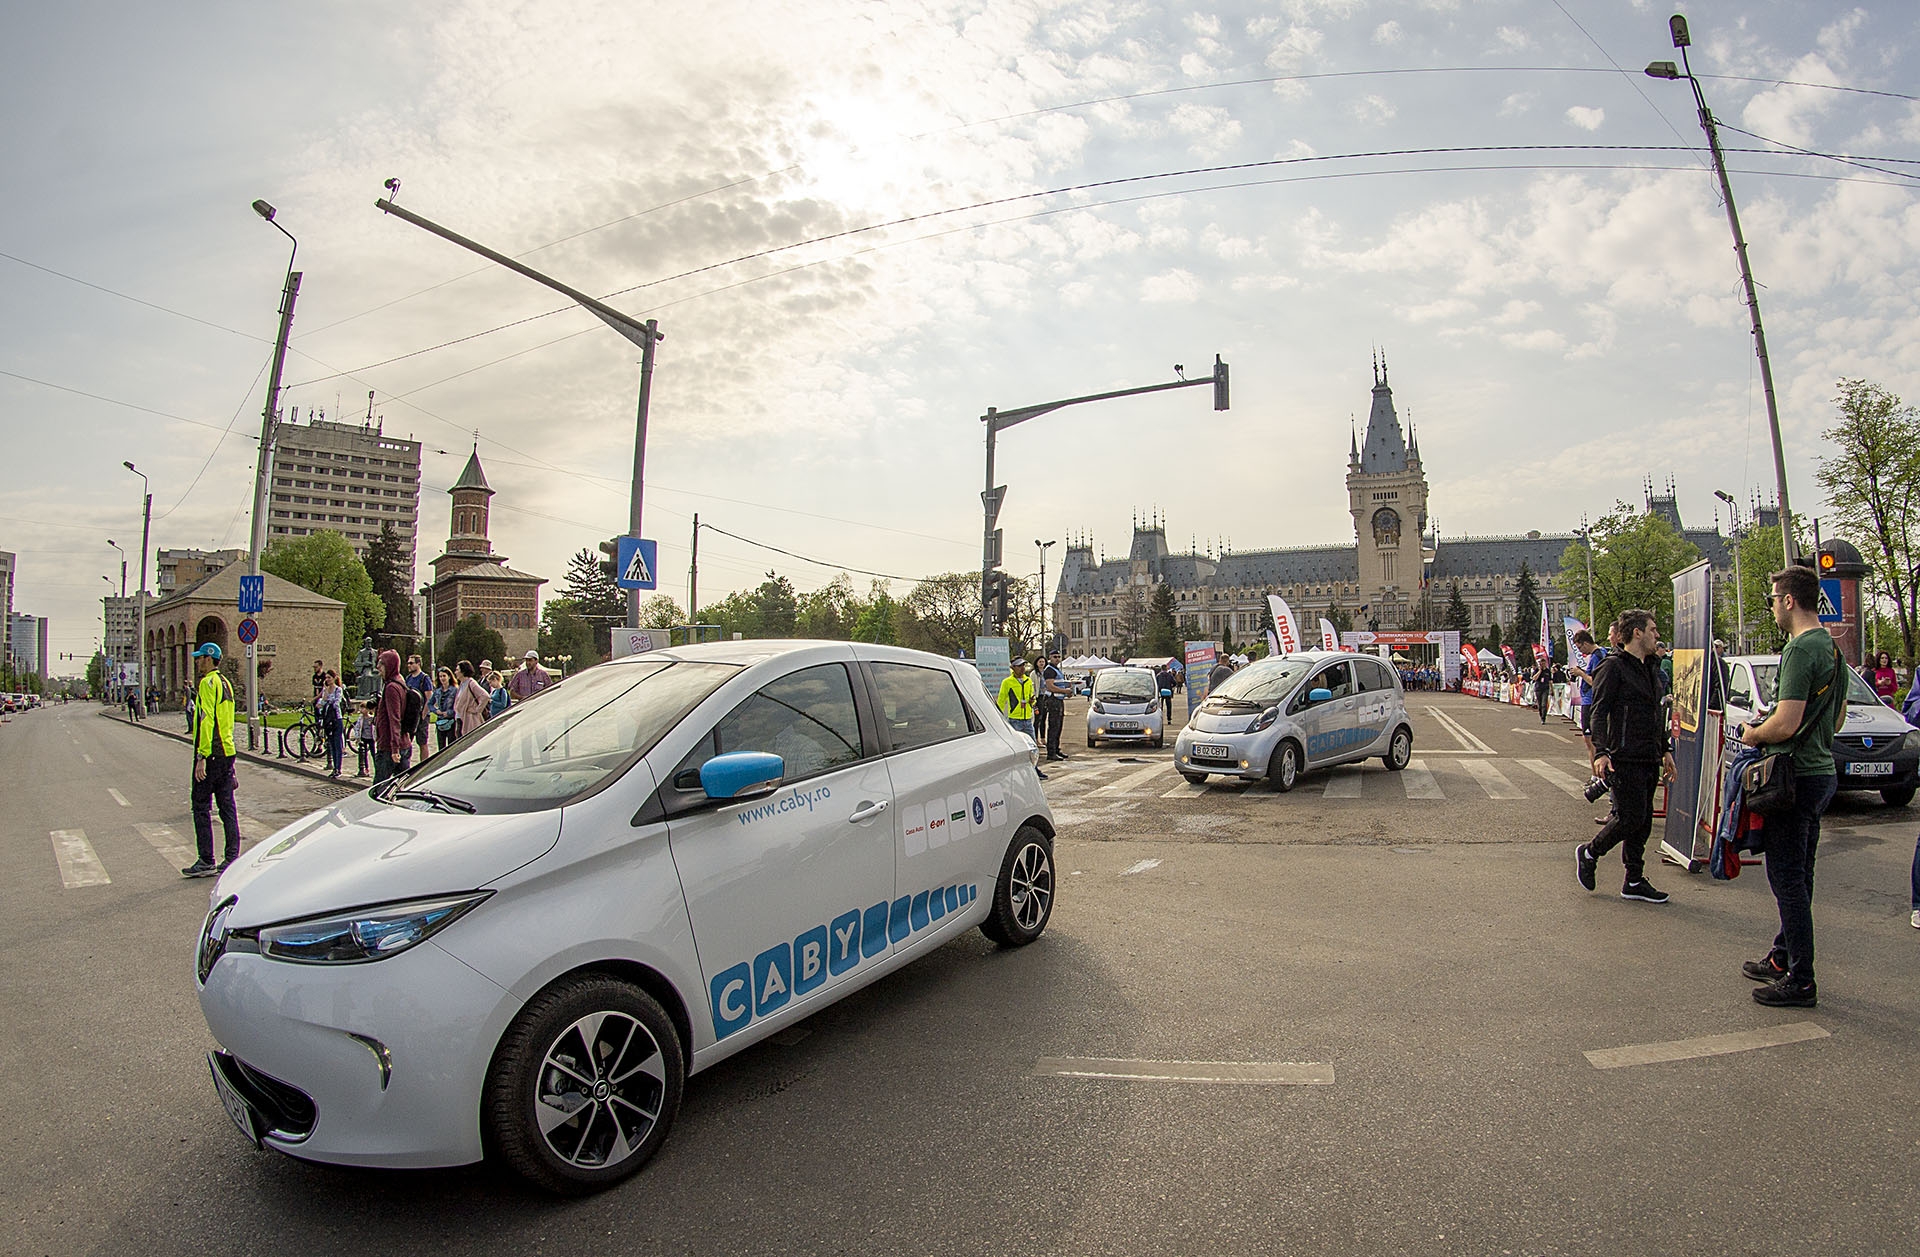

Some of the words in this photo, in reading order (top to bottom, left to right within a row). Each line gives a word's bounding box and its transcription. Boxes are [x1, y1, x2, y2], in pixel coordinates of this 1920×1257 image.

[1309, 729, 1346, 752] CABY
[1196, 746, 1202, 754] B
[1202, 746, 1210, 755] 02
[1210, 747, 1226, 756] CBY
[1852, 763, 1861, 774] IS
[1863, 763, 1870, 774] 11
[1873, 763, 1890, 774] XLK
[737, 786, 831, 826] www.caby.ro
[905, 827, 915, 835] Casa
[719, 921, 856, 1022] CABY
